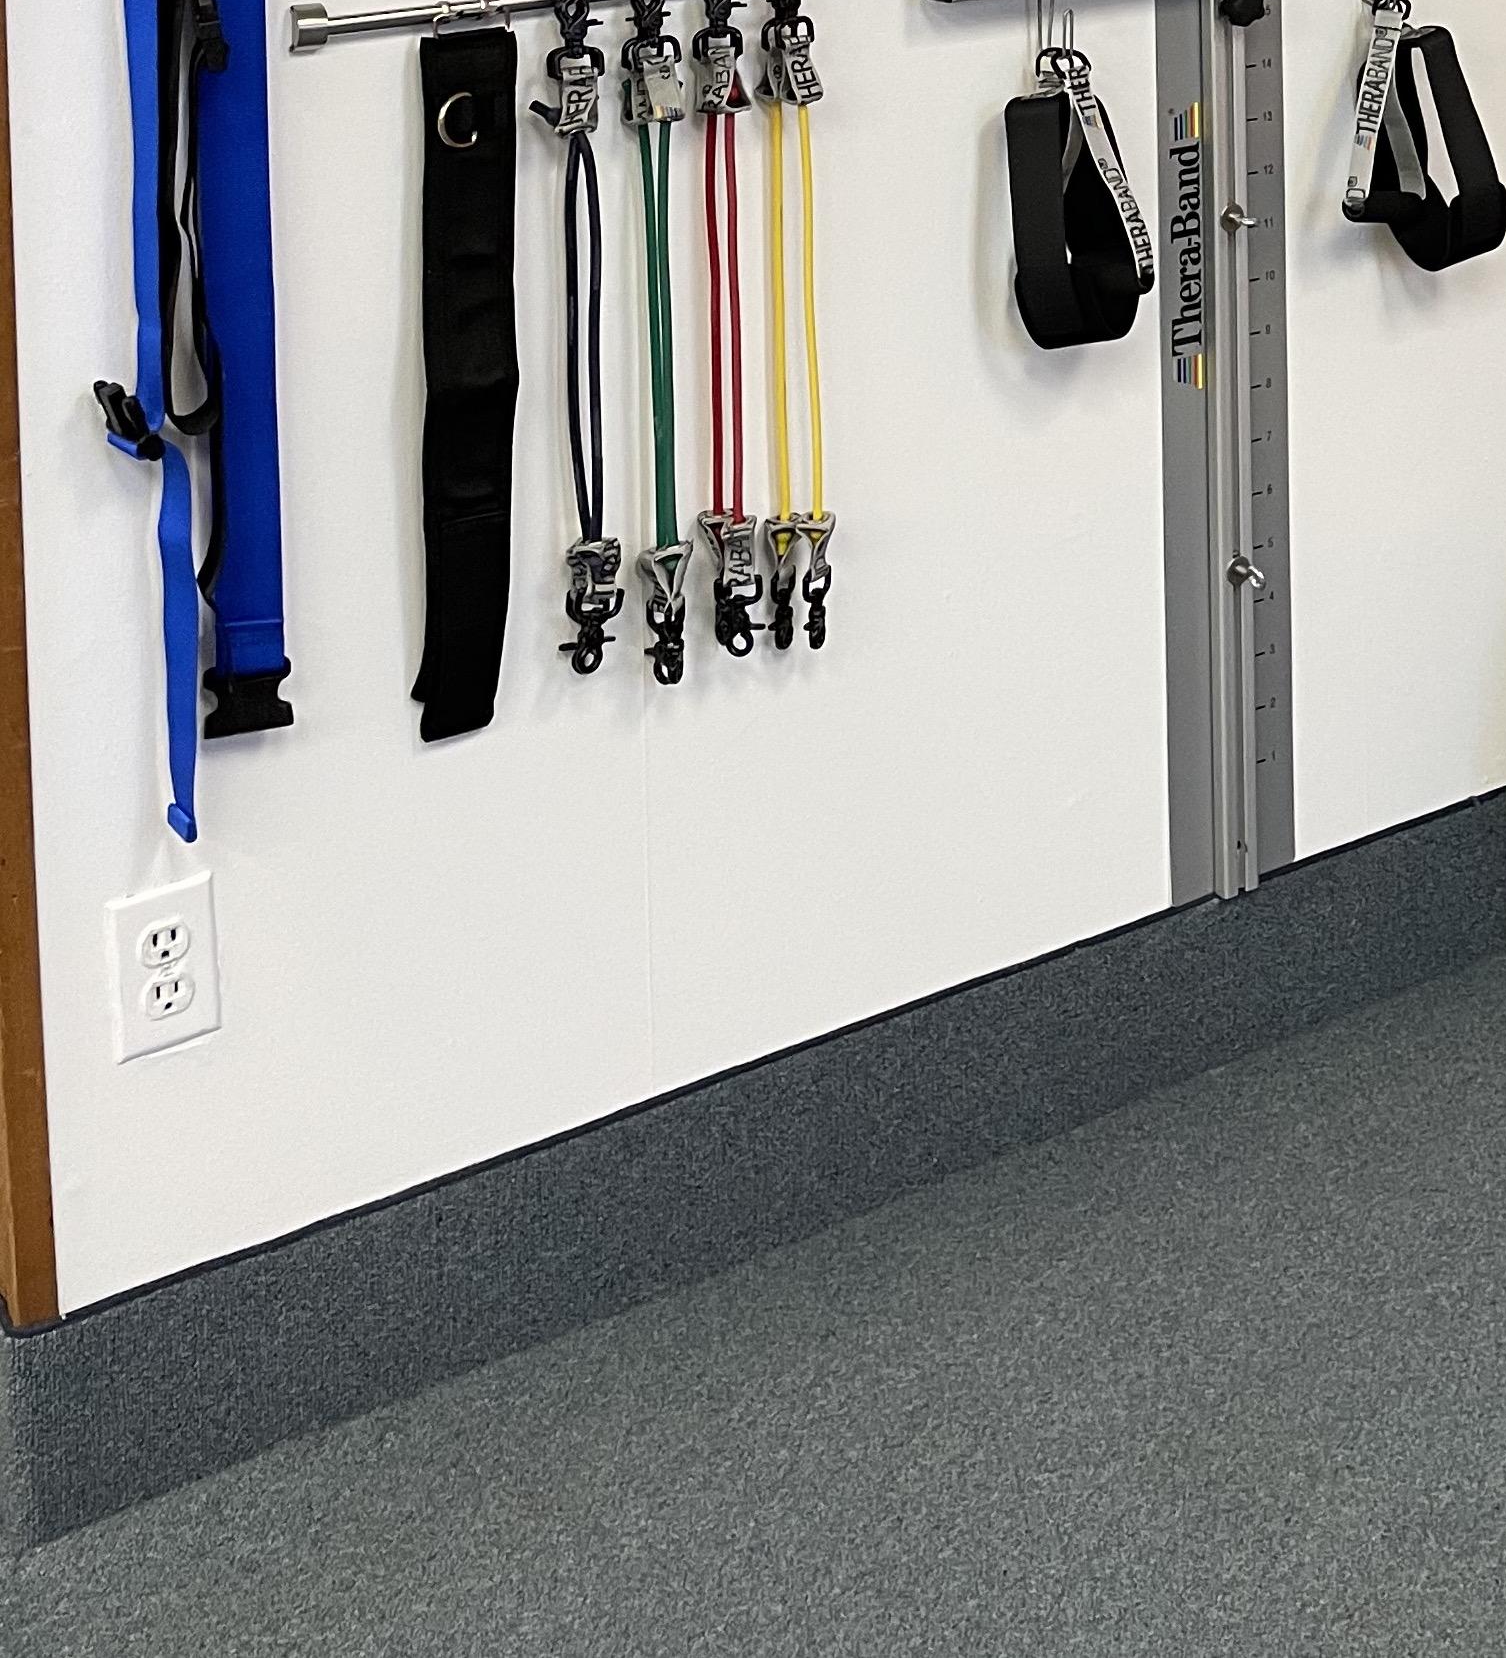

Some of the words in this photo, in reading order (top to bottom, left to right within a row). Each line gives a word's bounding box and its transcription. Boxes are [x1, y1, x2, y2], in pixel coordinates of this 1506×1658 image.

[1262, 59, 1271, 68] 14
[1264, 164, 1273, 174] 12
[1264, 217, 1273, 227] 11
[1169, 142, 1202, 357] Thera-Band
[1266, 270, 1275, 280] 10
[1267, 430, 1271, 441] 7
[1267, 484, 1272, 494] 6
[1270, 591, 1274, 600] 4
[1270, 697, 1276, 708] 2
[1272, 750, 1275, 760] 1
